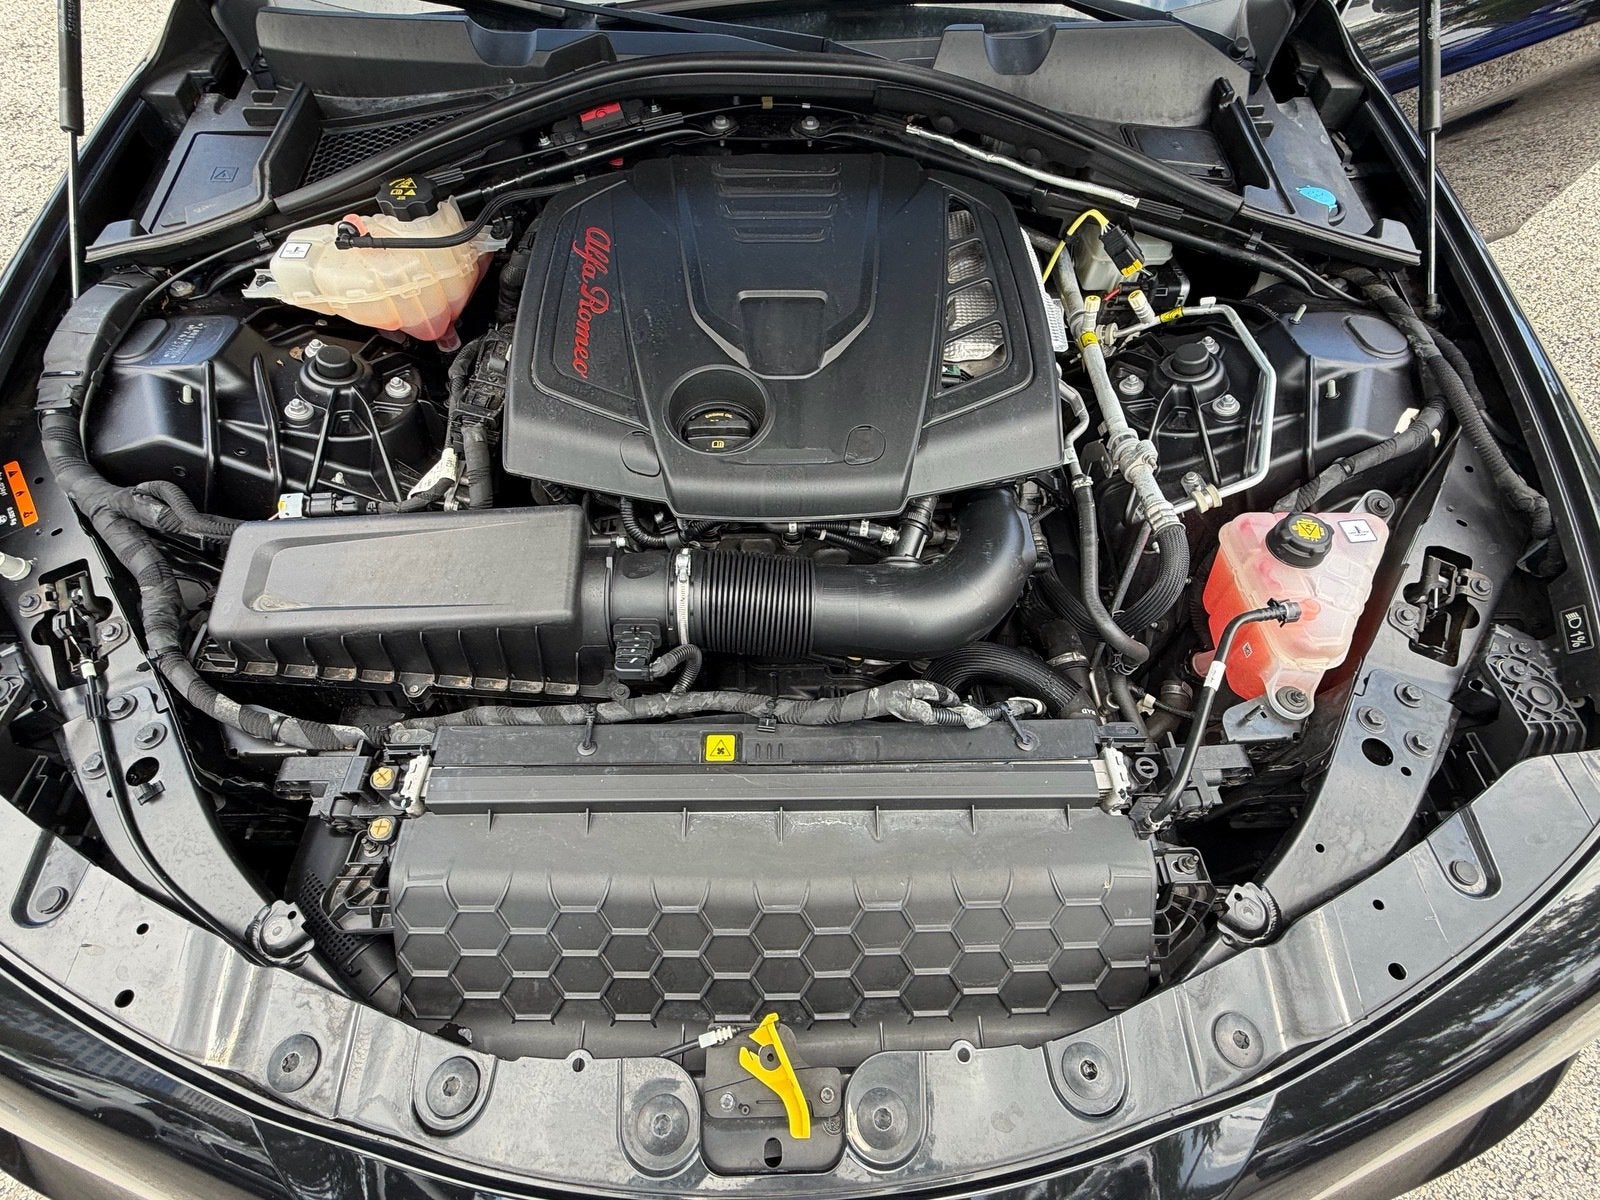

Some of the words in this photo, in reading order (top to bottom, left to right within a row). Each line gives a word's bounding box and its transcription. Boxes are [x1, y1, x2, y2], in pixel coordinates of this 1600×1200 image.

[572, 226, 611, 284] Alfa
[573, 283, 610, 379] Romeo
[1570, 630, 1587, 648] 1%
